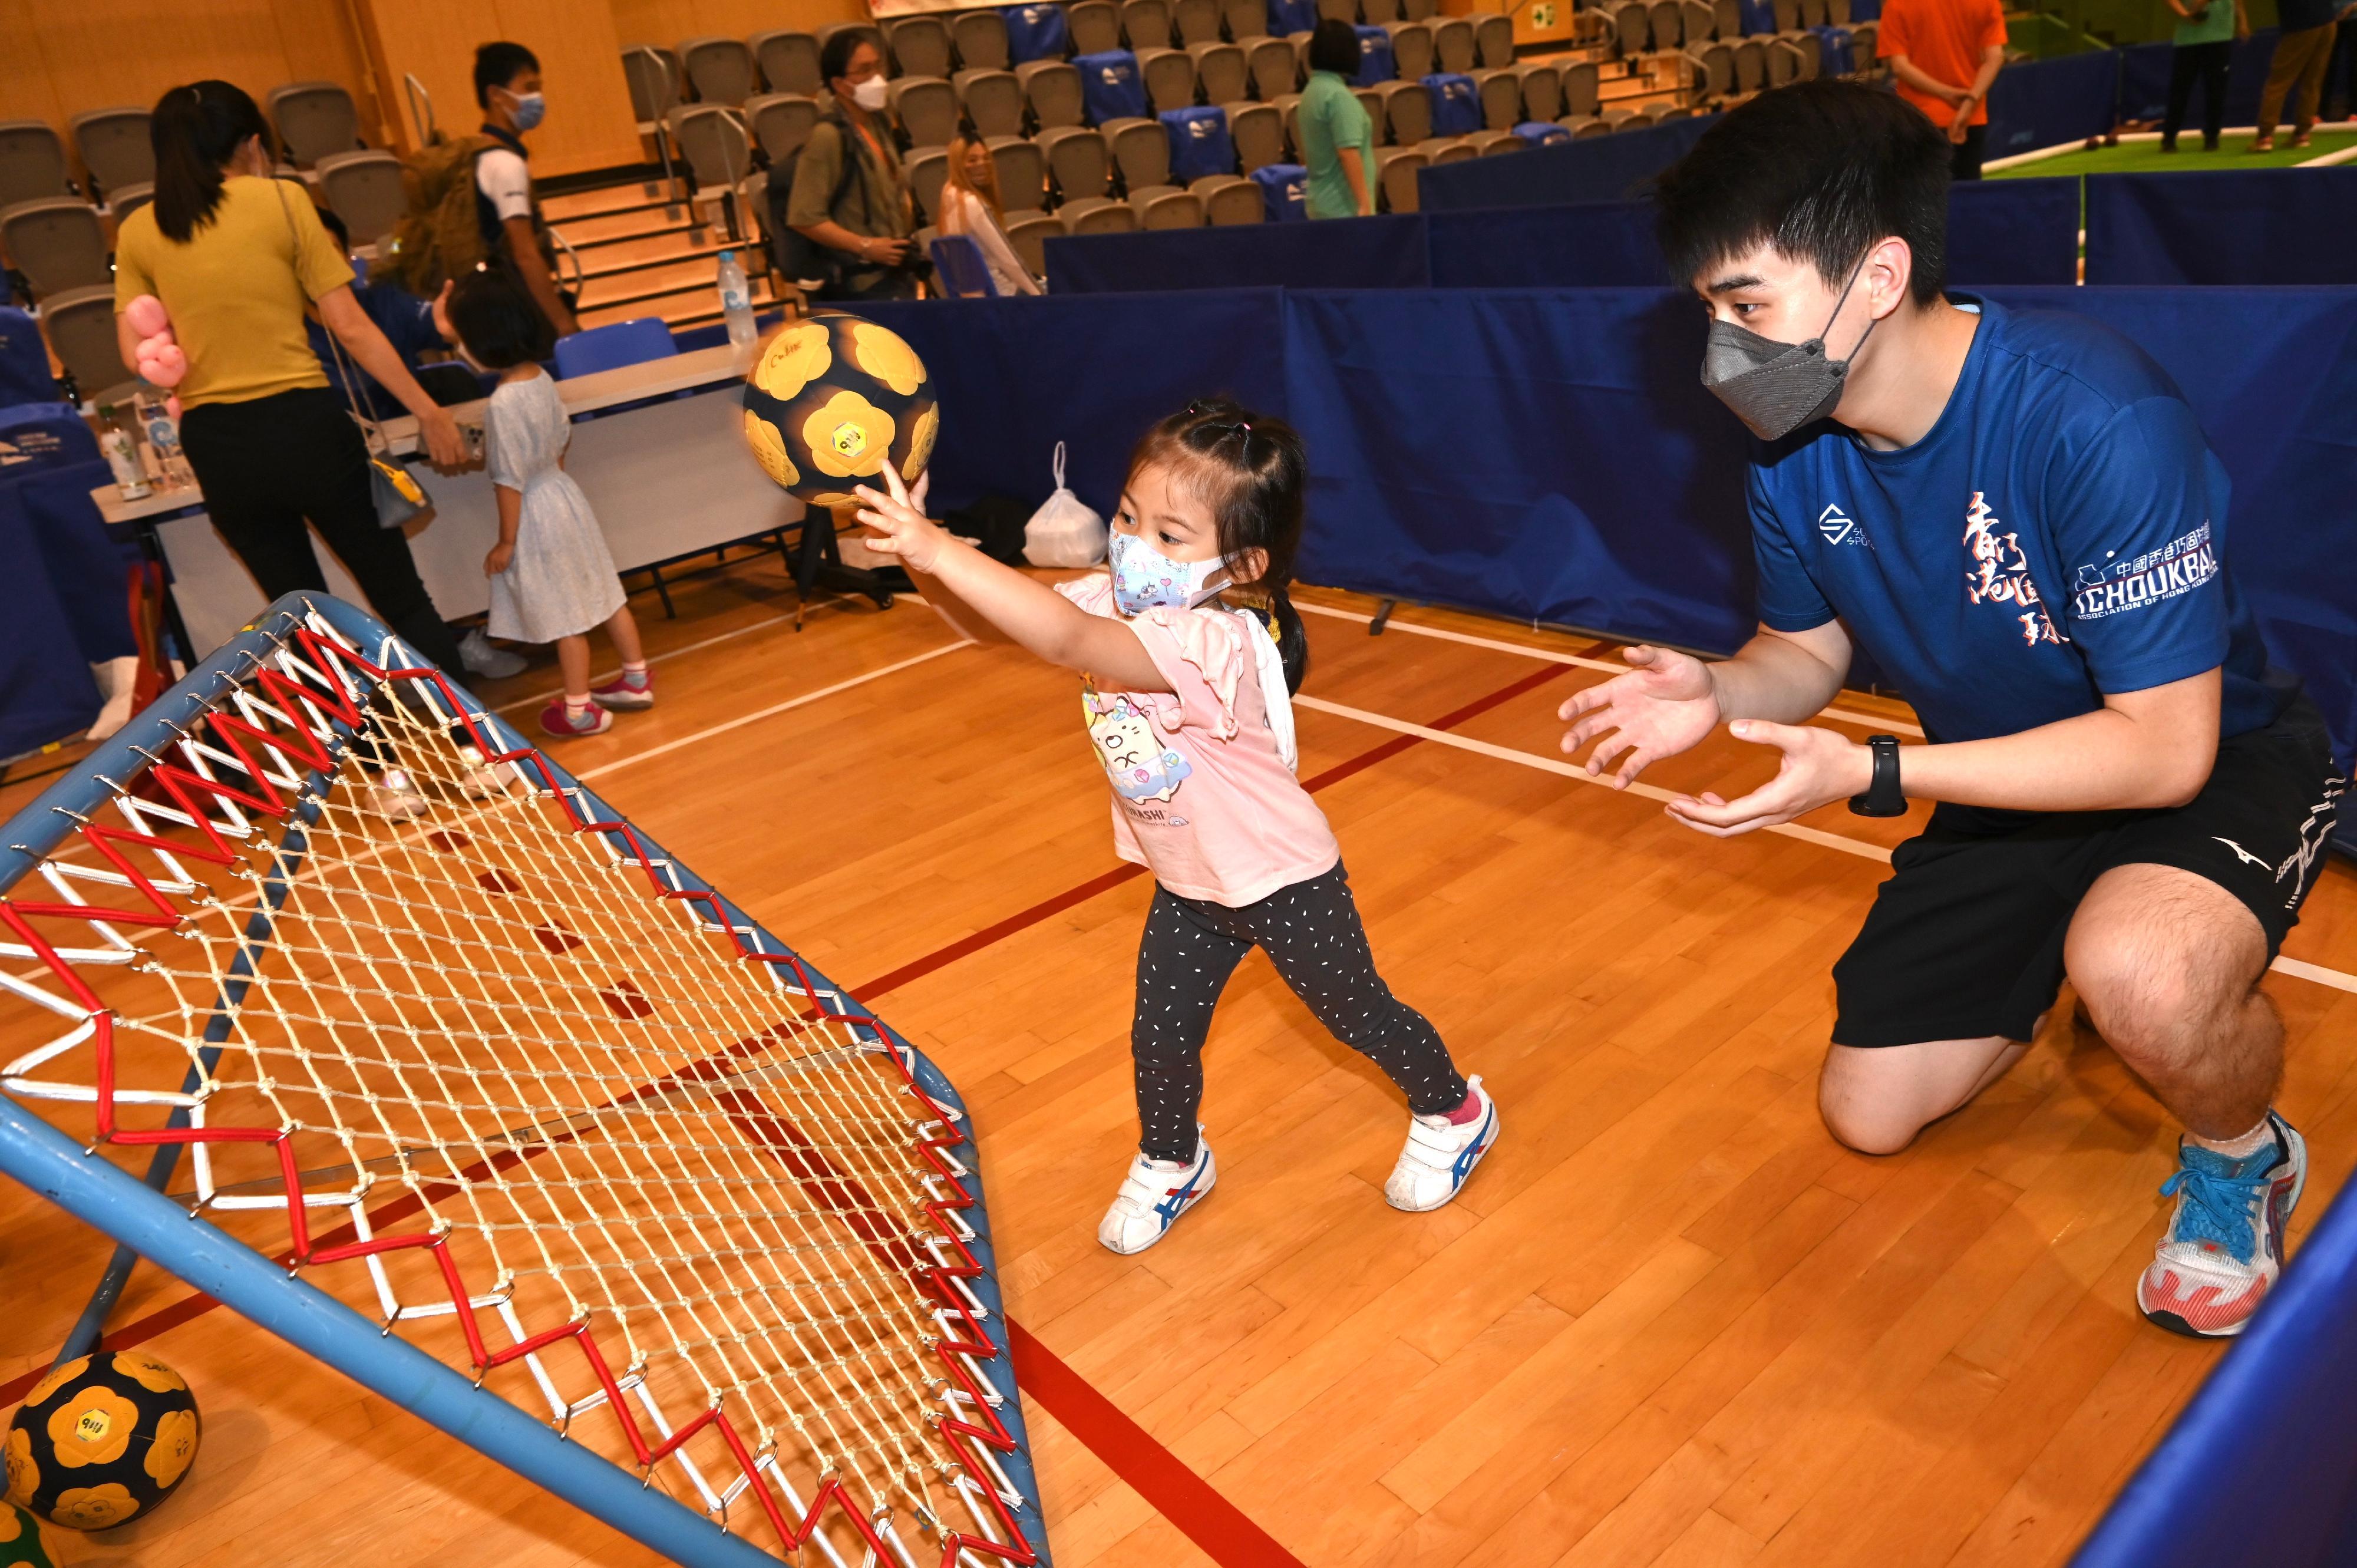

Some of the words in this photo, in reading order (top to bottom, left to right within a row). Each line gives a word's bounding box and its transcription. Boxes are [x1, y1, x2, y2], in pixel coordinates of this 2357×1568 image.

[2078, 600, 2141, 620] ASSOCIATION
[2144, 597, 2159, 606] OF
[2162, 585, 2190, 600] HONG
[2191, 574, 2210, 589] KONG
